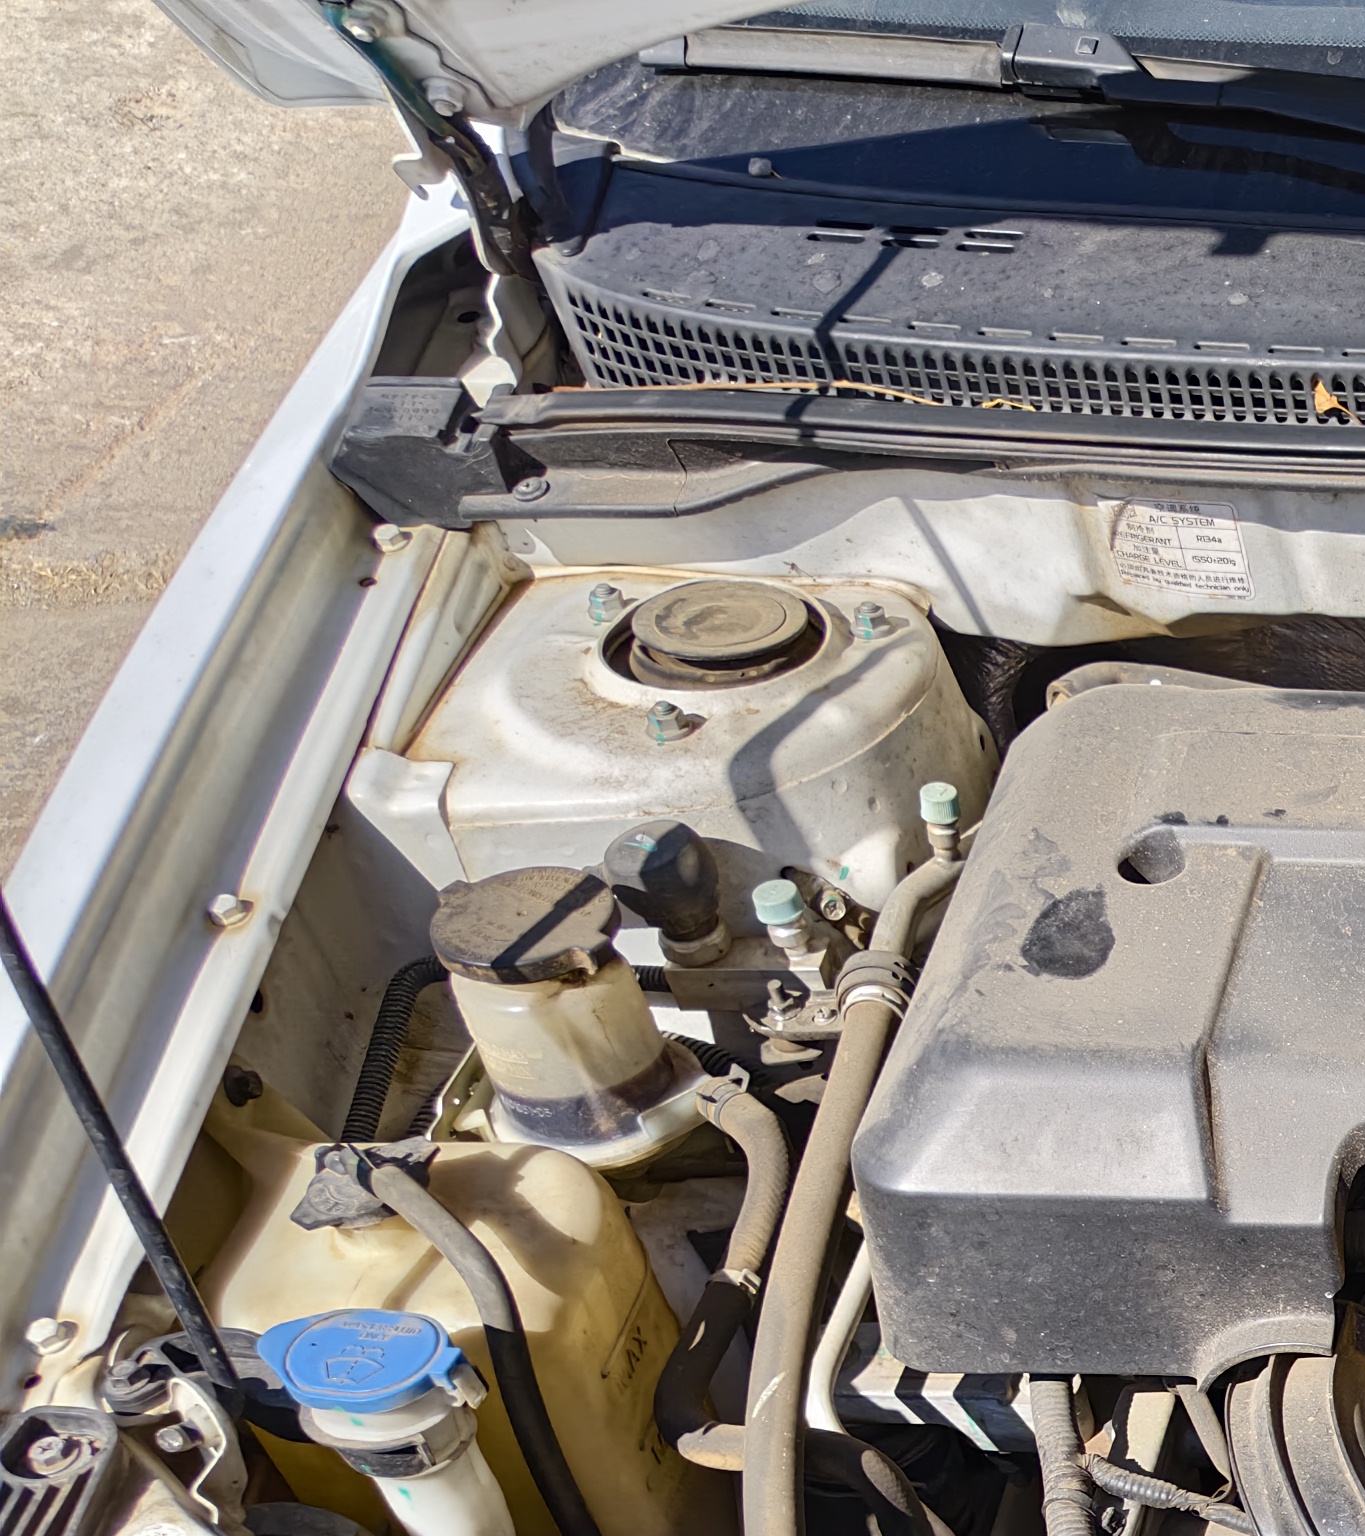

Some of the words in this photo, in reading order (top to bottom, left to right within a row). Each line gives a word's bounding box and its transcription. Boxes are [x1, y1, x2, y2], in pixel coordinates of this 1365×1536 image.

[1149, 515, 1167, 525] A/C
[1171, 516, 1215, 526] SYSTEM
[1195, 534, 1223, 544] R134a
[1116, 550, 1150, 562] CHARGE
[1153, 556, 1183, 568] LEVEL
